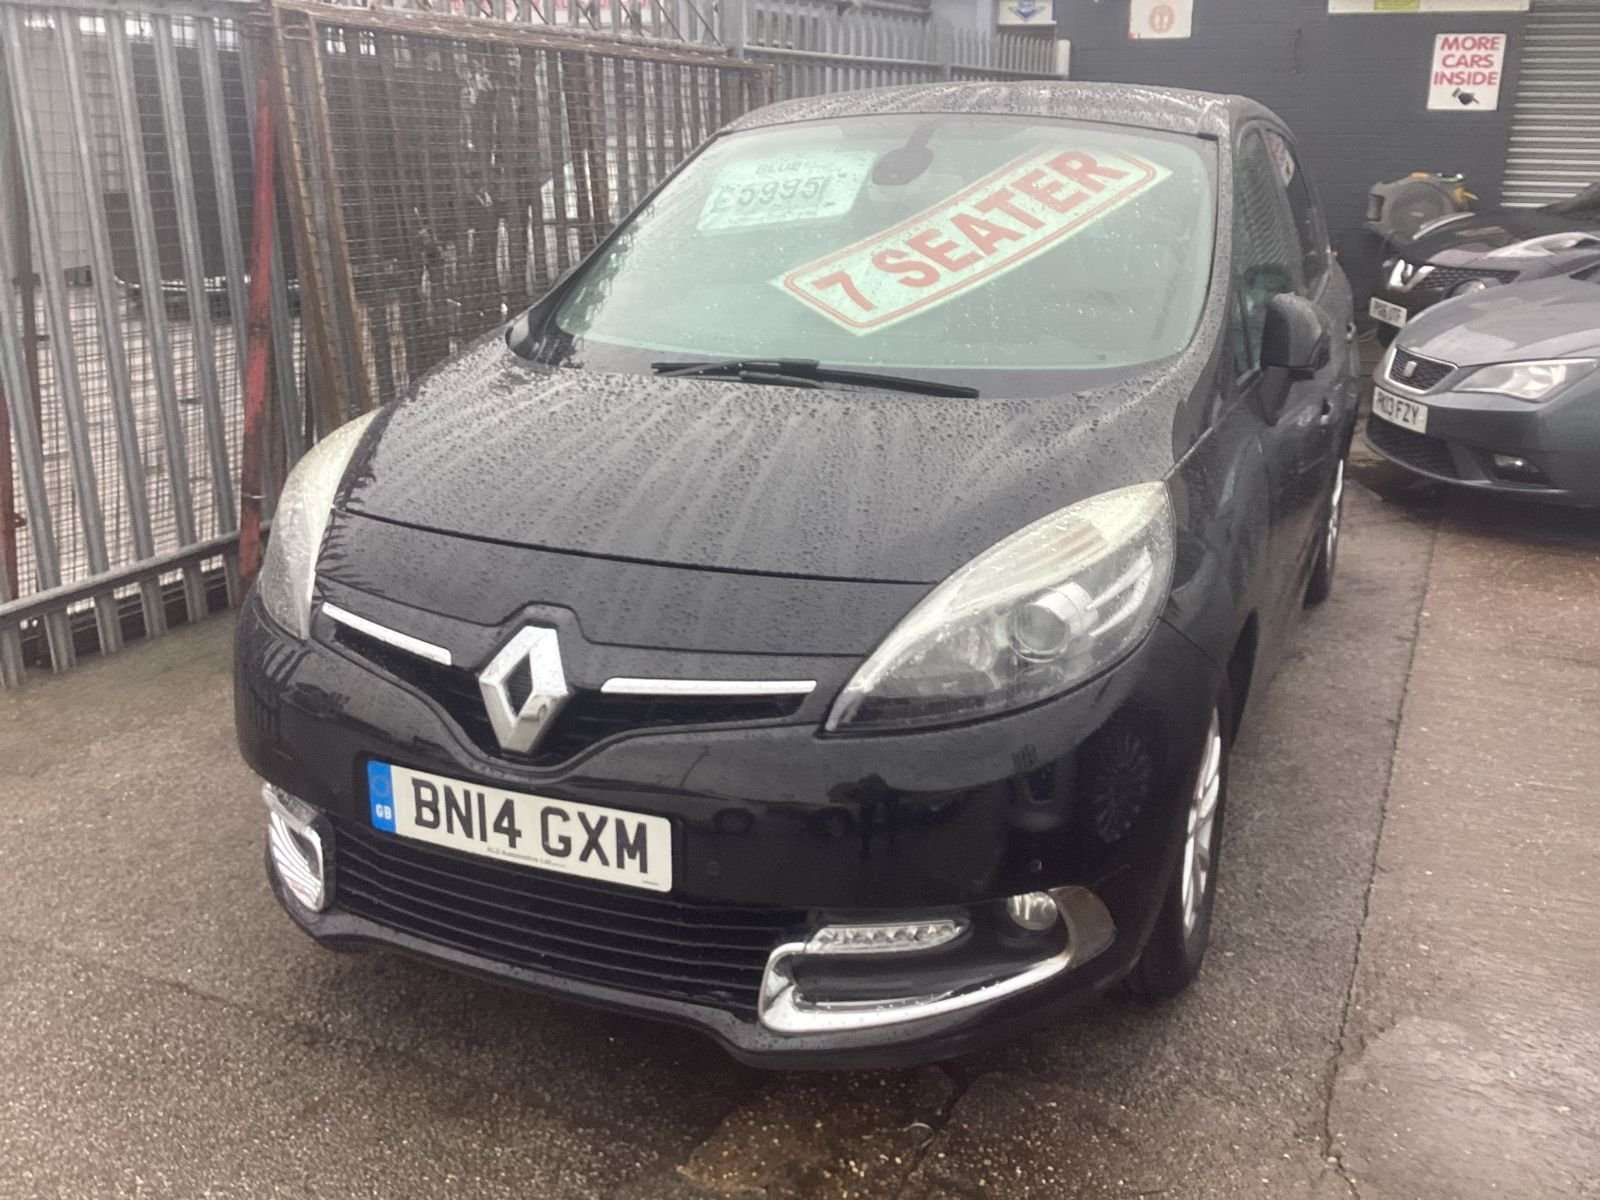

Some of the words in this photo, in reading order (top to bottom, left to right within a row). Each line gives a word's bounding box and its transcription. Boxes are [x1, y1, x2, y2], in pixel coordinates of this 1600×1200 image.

[1440, 36, 1502, 51] MORE
[1442, 54, 1494, 69] CARS
[1433, 71, 1499, 86] INSIDE
[815, 271, 879, 312] 7
[871, 148, 1129, 289] SEATER
[1395, 400, 1420, 425] FZY
[375, 803, 393, 820] GB
[411, 777, 522, 849] BN14
[540, 805, 649, 874] GXM
